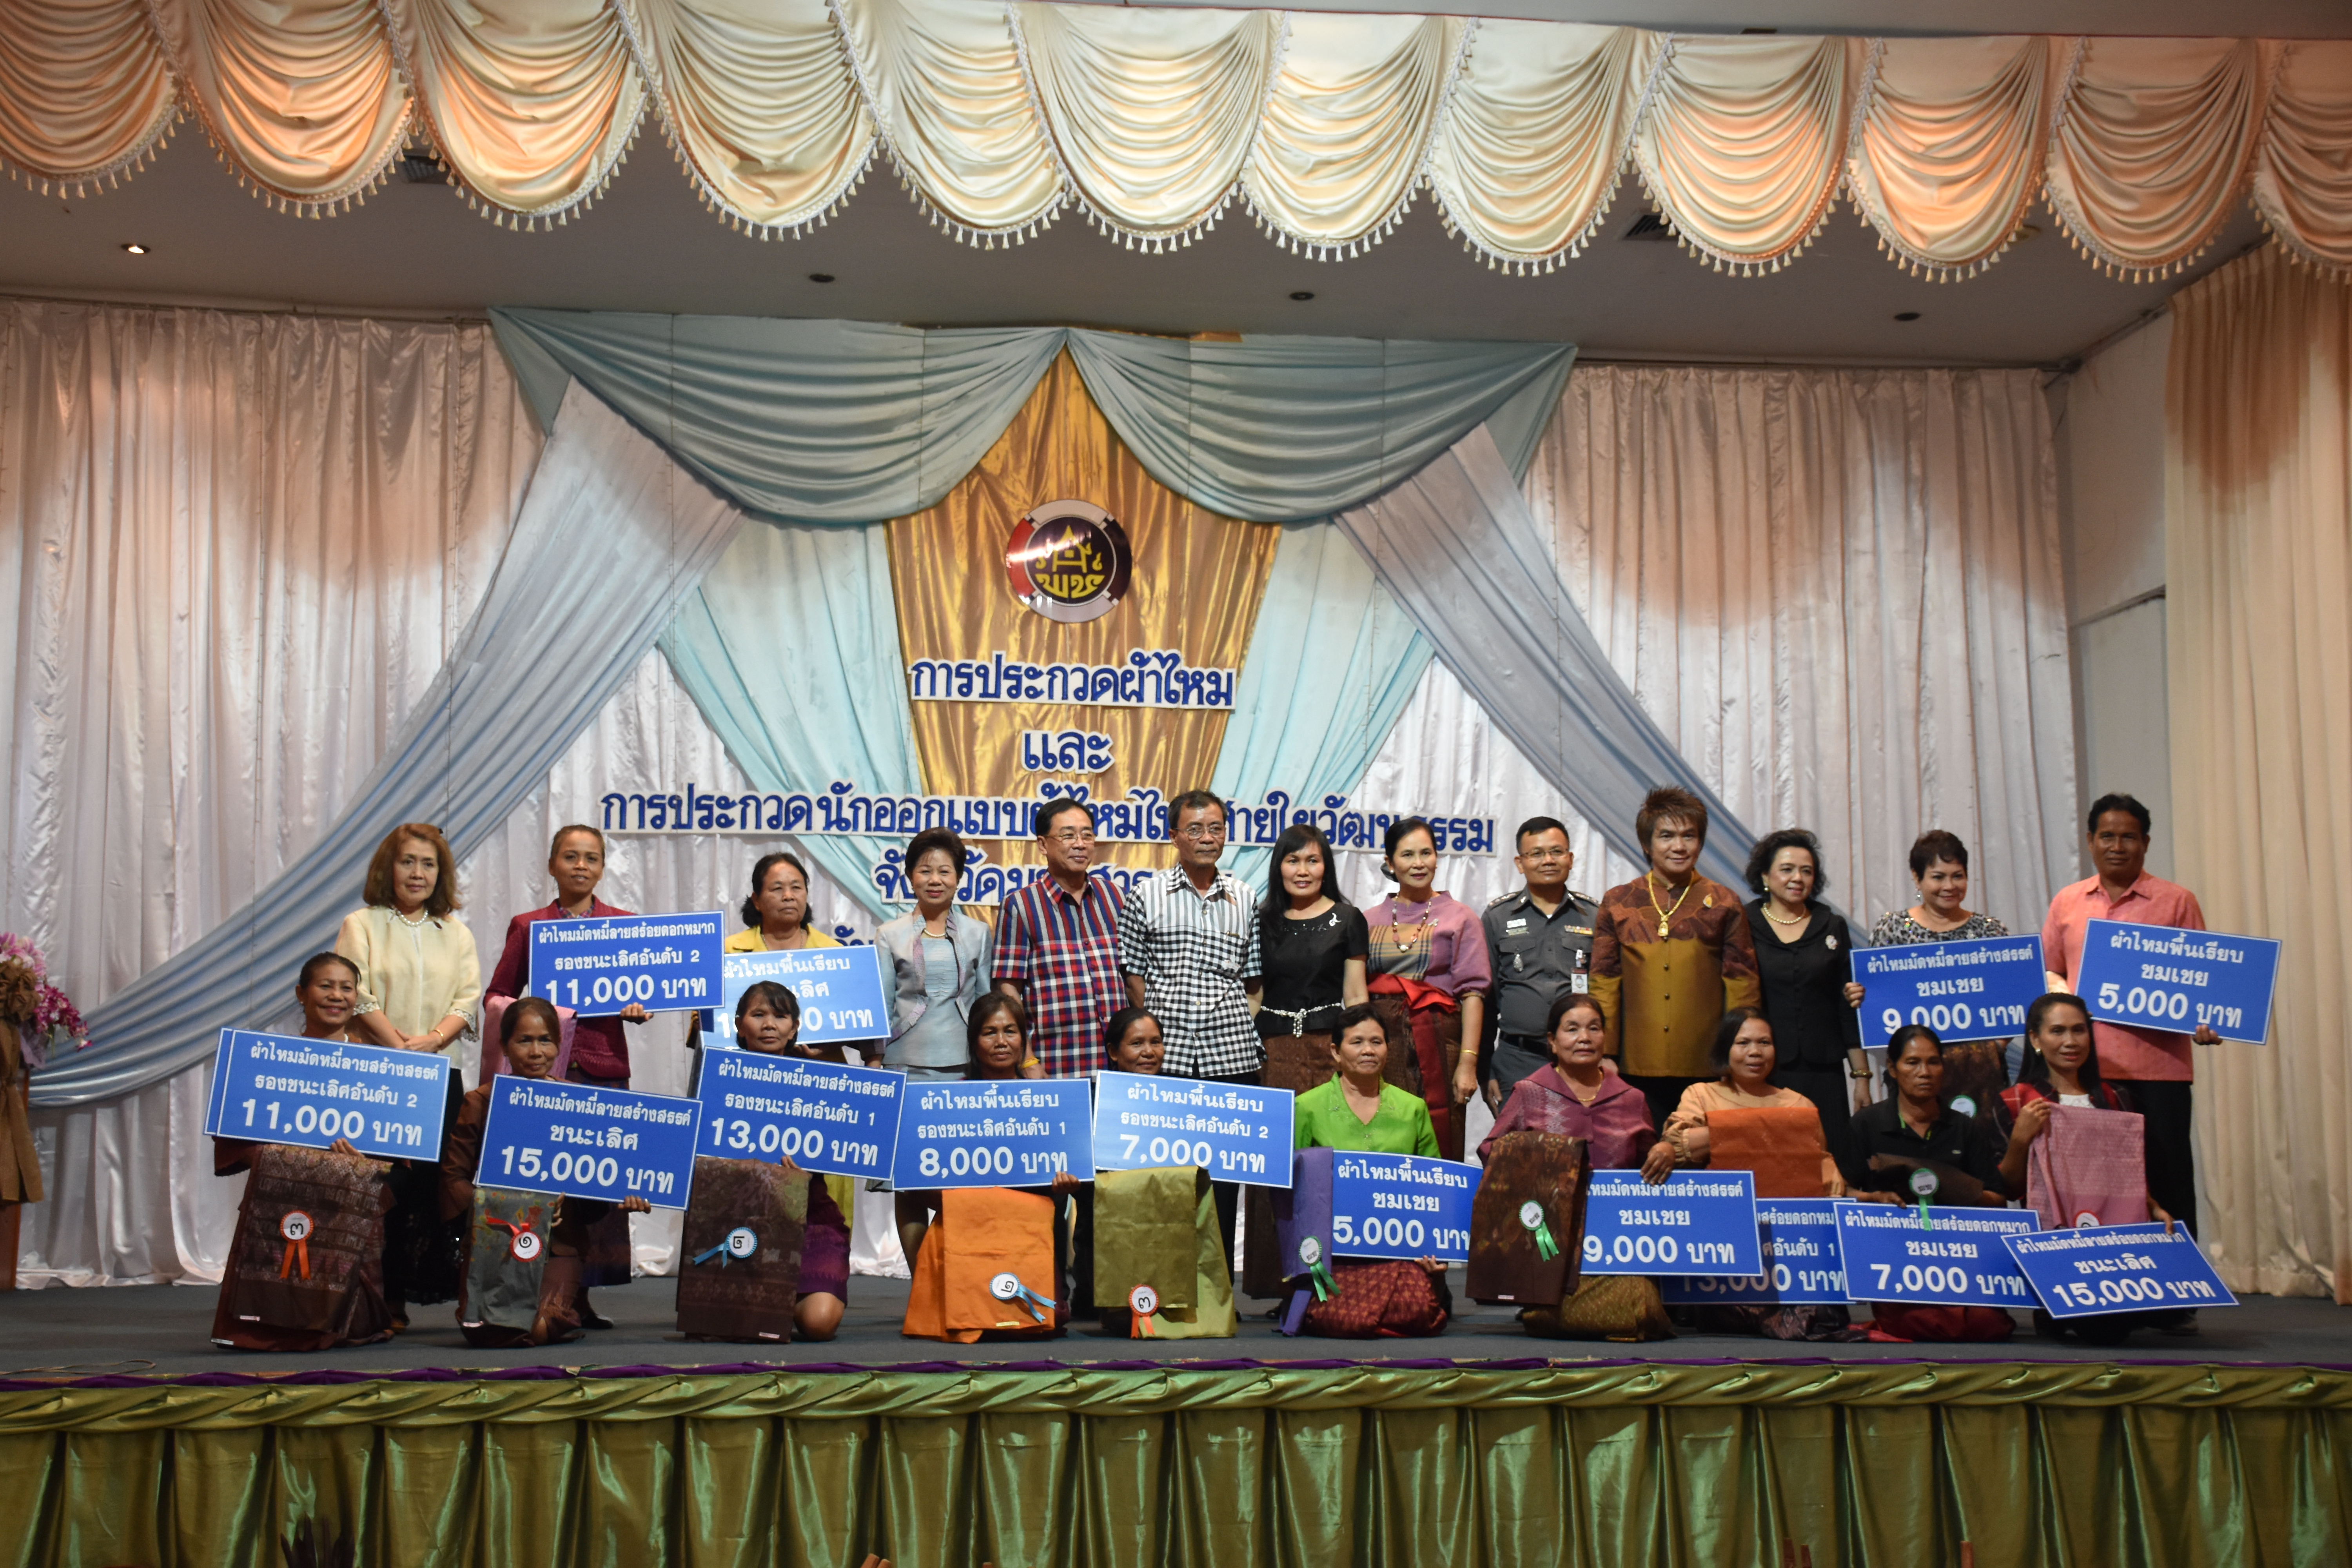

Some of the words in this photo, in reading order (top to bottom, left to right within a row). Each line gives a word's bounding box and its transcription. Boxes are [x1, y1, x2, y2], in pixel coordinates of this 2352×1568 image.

[913, 652, 1232, 706] การประกวดผ้าไหม
[1024, 731, 1111, 770] และ
[555, 946, 682, 971] รองชนะเลิศอันดับ
[690, 949, 700, 962] 2
[2111, 929, 2246, 964] ผ้าไหมพื้นเรียบ
[1916, 977, 1984, 997] ชมเชย
[2141, 964, 2209, 987] ชมเชย
[546, 974, 654, 1009] 11,000
[661, 977, 706, 999] บาท
[2098, 982, 2188, 1020] 5,000
[2196, 1003, 2242, 1028] บาท
[829, 1009, 873, 1029] บาท
[1882, 1003, 1971, 1035] 9000
[1979, 1005, 2025, 1027] บาท
[255, 1074, 399, 1105] รองชนะเลิศอันดับ
[407, 1094, 417, 1108] 2
[921, 1084, 1059, 1110] ผ้าไหมพื้นเรียบ
[1127, 1082, 1265, 1112] ผ้าไหมพื้นเรียบ
[243, 1098, 365, 1140] 11,000
[372, 1120, 422, 1146] บาท
[725, 1093, 859, 1124] รองชนะเลิศอันดับ
[869, 1112, 875, 1126] 1
[550, 1125, 638, 1151] ชนะเลิศ
[917, 1117, 1049, 1139] รองชนะเลิศอันดับ
[1059, 1122, 1065, 1135] 1
[1120, 1112, 1250, 1136] รองชนะเลิศอันดับ
[1259, 1126, 1269, 1139] 2
[712, 1118, 824, 1158] 13,000
[831, 1140, 878, 1166] บาท
[1120, 1133, 1212, 1167] 7,000
[1219, 1150, 1265, 1173] บาท
[502, 1146, 618, 1187] 15,000
[626, 1167, 674, 1194] บาท
[920, 1146, 1013, 1178] 8,000
[1021, 1152, 1068, 1174] บาท
[1338, 1158, 1469, 1188] ผ้าไหมพื้นเรียบ
[1372, 1192, 1439, 1212] ชมเชย
[1333, 1216, 1425, 1248] 5,000
[1619, 1210, 1690, 1225] ชมเชย
[1583, 1235, 1678, 1265] 9,000
[1686, 1243, 1735, 1264] บาท
[1828, 1243, 1835, 1256] 1
[1906, 1241, 1978, 1258] ชมเชย
[2074, 1252, 2157, 1274] ชนะเลิศ
[1798, 1269, 1846, 1291] บาท
[1870, 1263, 1968, 1293] 7,000
[1975, 1273, 2028, 1296] บาท
[2053, 1277, 2164, 1307] 15,000
[2165, 1281, 2216, 1299] บาท
